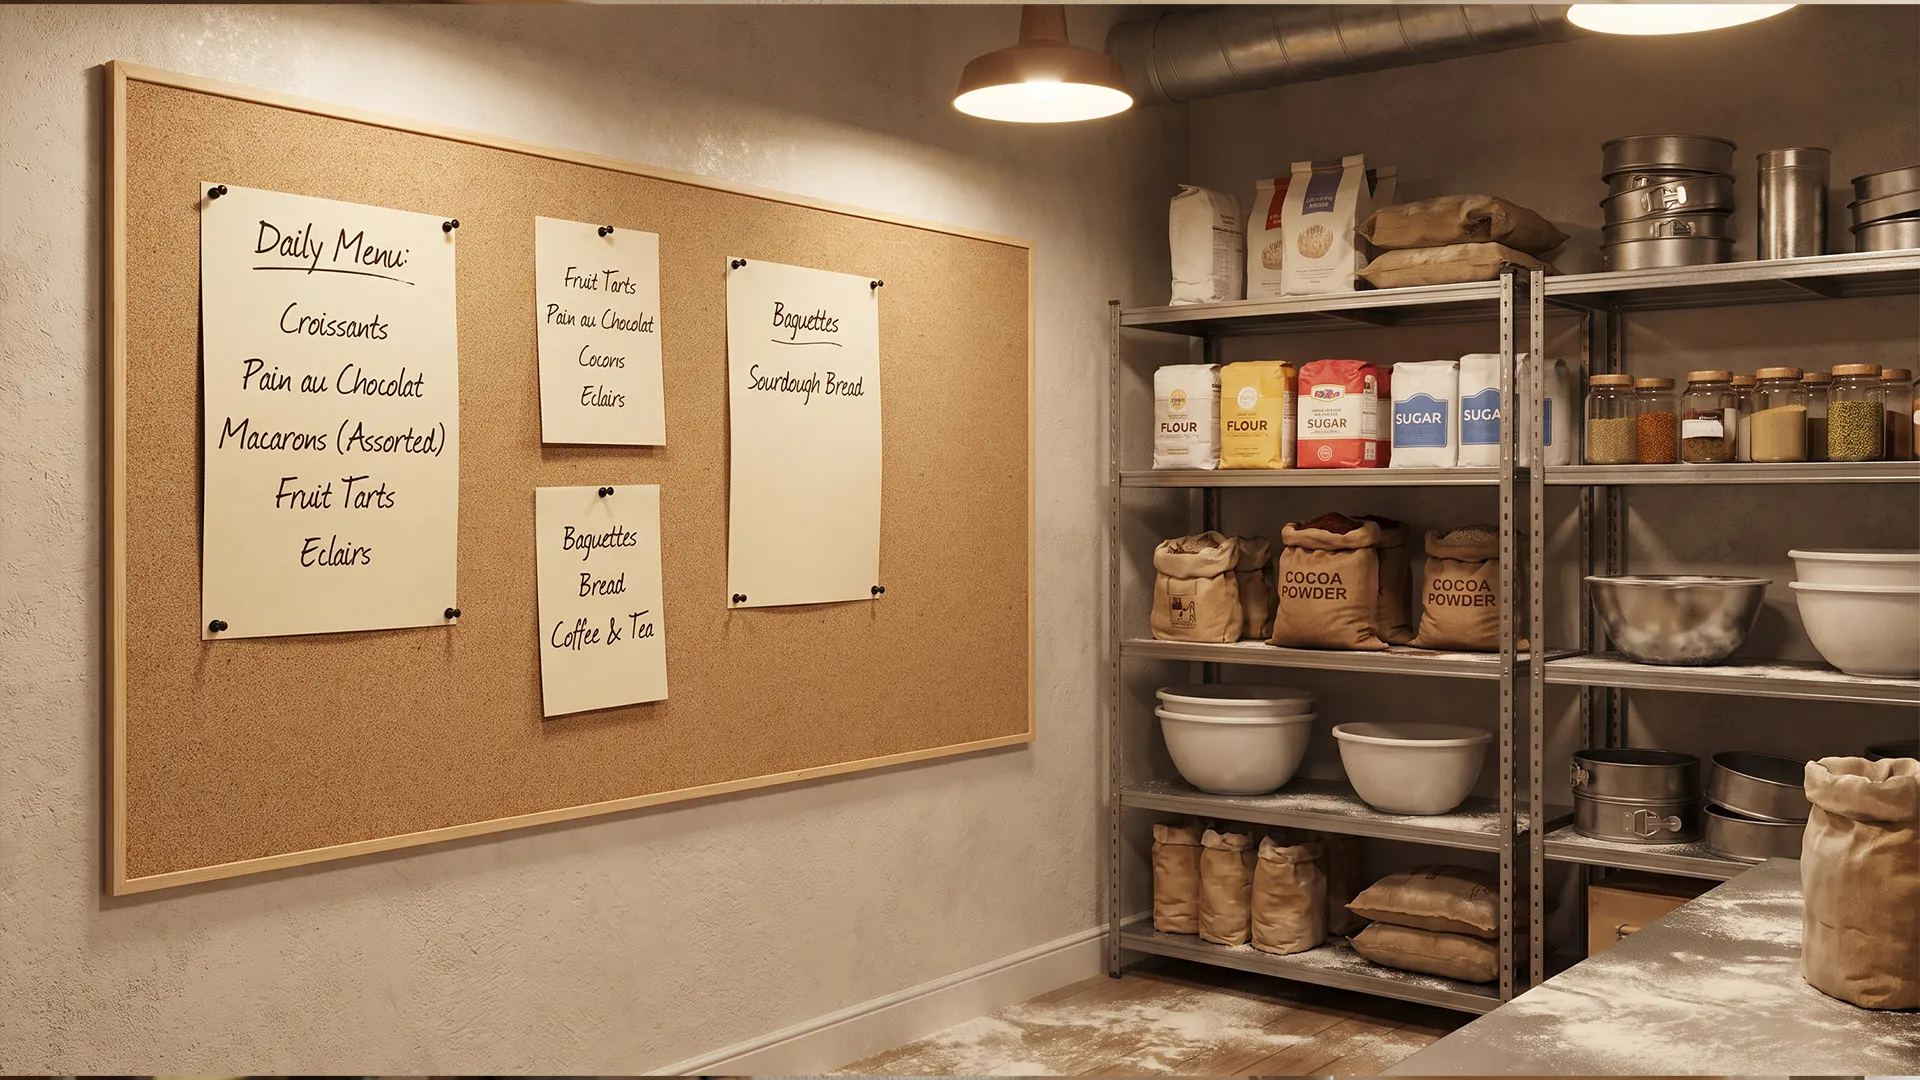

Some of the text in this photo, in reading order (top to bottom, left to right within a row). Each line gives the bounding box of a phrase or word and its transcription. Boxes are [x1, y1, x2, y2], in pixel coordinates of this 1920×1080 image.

[253, 219, 410, 274] Daily Menu:
[564, 266, 636, 295] Fruit Tarts
[279, 302, 389, 340] Croissants
[546, 303, 654, 334] Pain au Chocolat
[772, 301, 839, 340] Baguettes
[242, 358, 424, 398] Pain au Chocolat
[747, 364, 865, 405] Sourdough Bread
[580, 384, 626, 408] Eclairs
[1161, 421, 1198, 433] FLOUR
[1227, 420, 1268, 431] FLOUR
[1307, 418, 1347, 429] SUGAR
[1395, 412, 1442, 425] SUGAR
[1463, 408, 1500, 421] SUGA
[218, 416, 445, 458] Macarons (Assorted)
[275, 475, 396, 510] Fruit Tarts
[300, 534, 372, 568] Eclairs
[562, 525, 638, 561] Baguettes
[578, 572, 627, 598] Bread
[1285, 571, 1343, 585] COCOA
[1432, 578, 1491, 592] COCOA
[1281, 586, 1348, 600] POWDER
[1428, 593, 1496, 607] POWDER
[551, 609, 655, 651] Coffee & Tea
